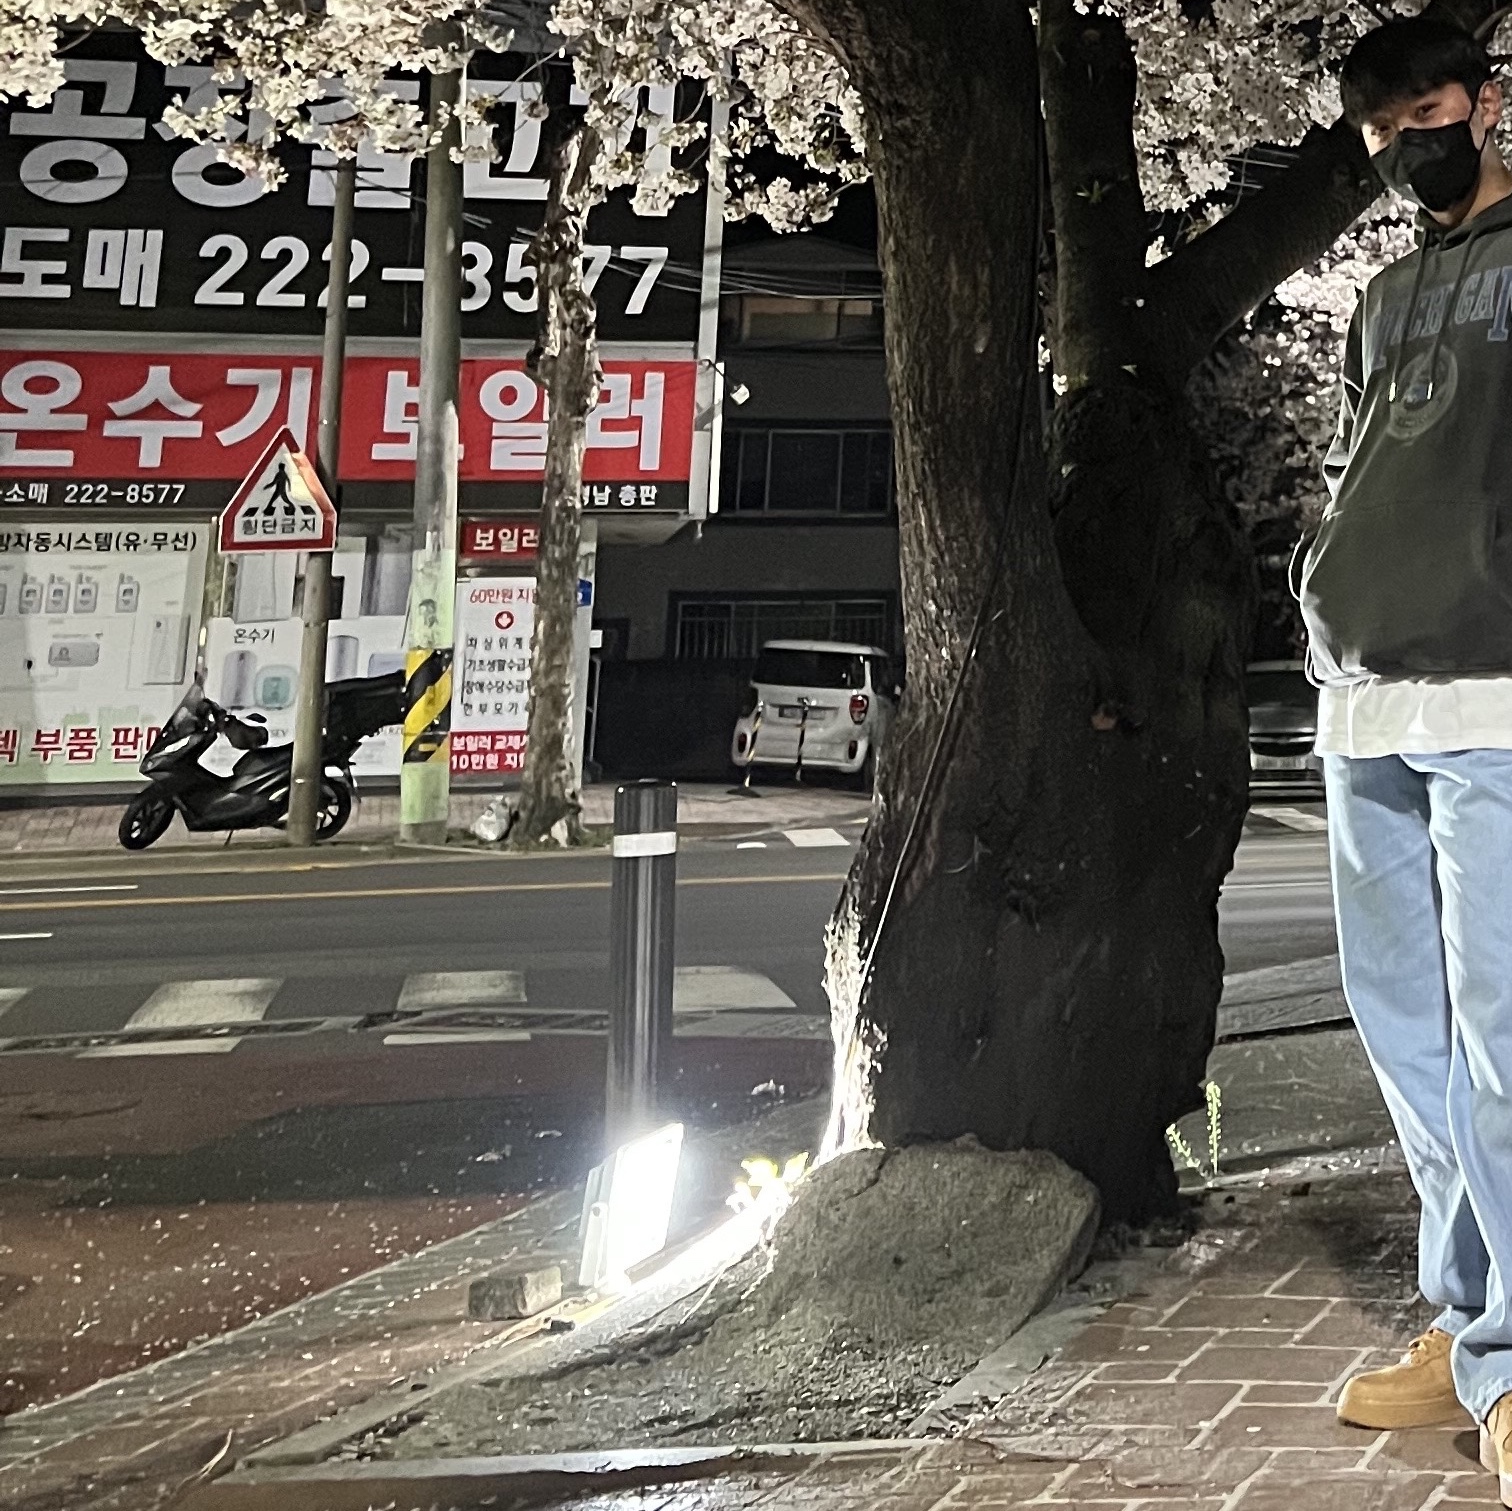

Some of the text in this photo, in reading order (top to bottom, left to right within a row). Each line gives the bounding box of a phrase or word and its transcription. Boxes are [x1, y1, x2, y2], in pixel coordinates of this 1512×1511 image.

[0, 226, 669, 315] 도매 222-8577
[0, 359, 313, 468] 온수기
[64, 483, 187, 504] 222-8577
[618, 484, 658, 507] 총판
[241, 518, 317, 535] 횡단금지
[233, 628, 276, 644] 온수기
[31, 726, 98, 762] 부품
[451, 735, 492, 752] 보일러
[451, 753, 499, 770] 10만원
